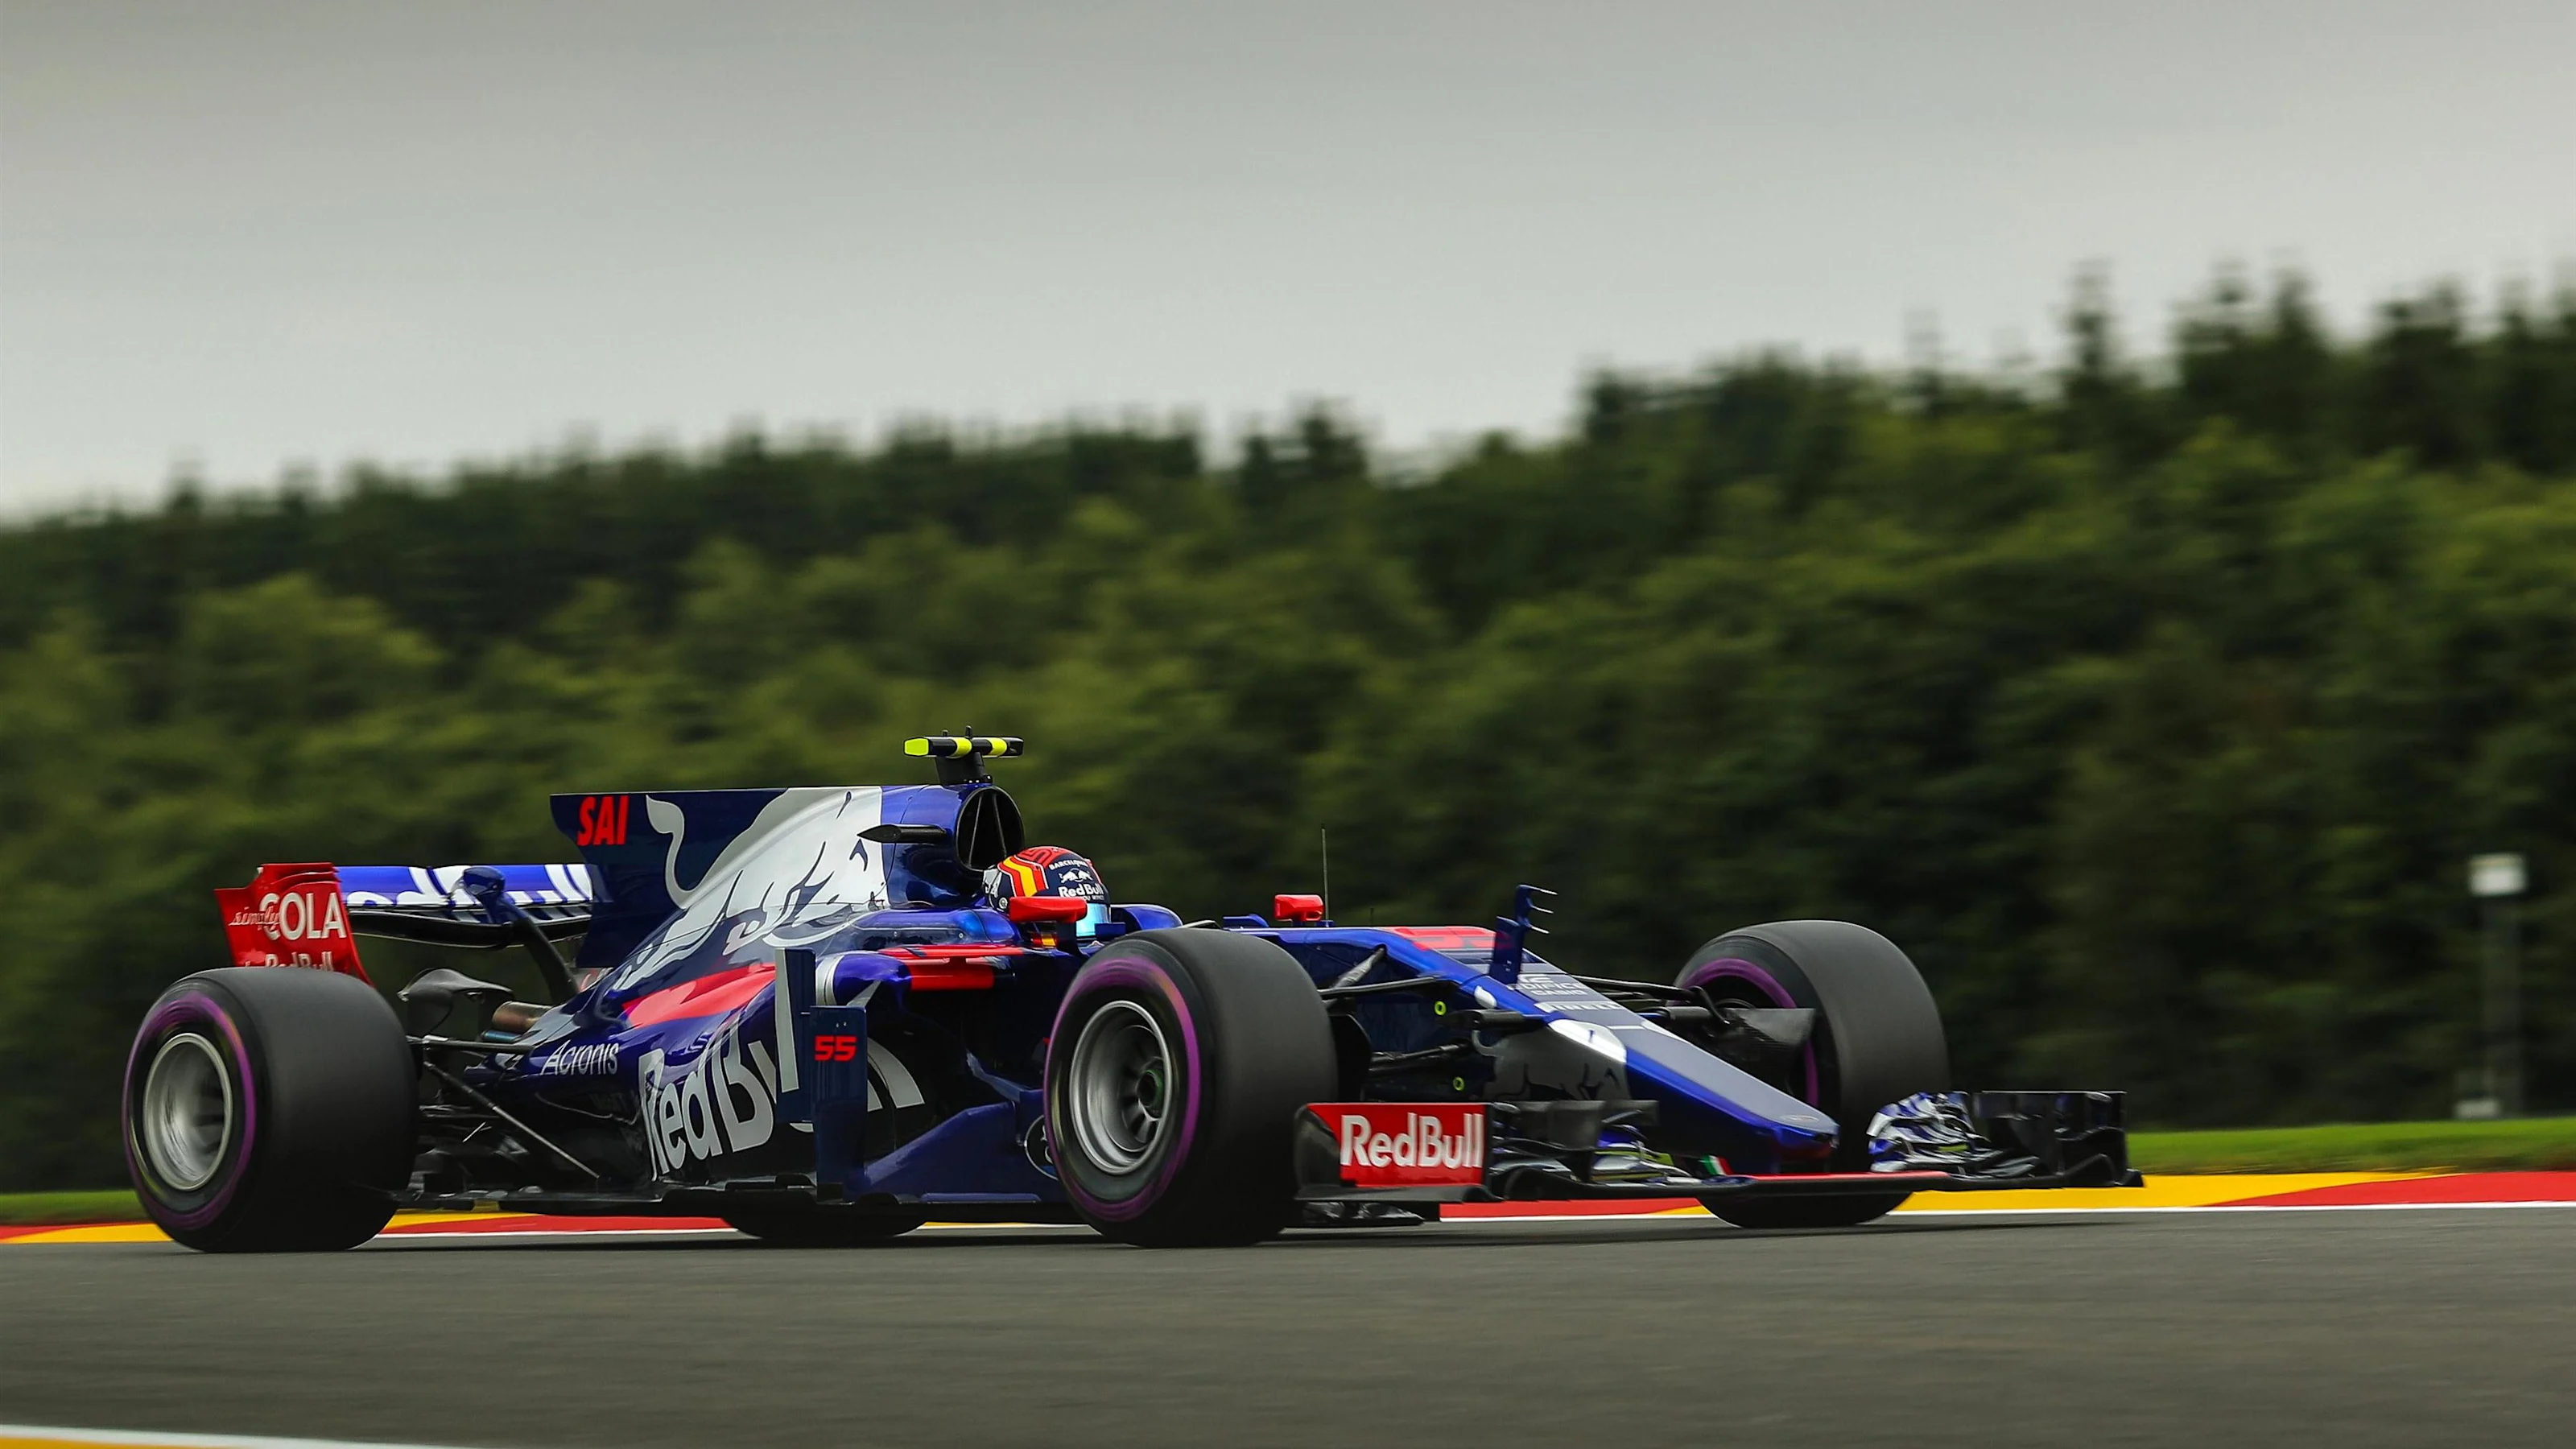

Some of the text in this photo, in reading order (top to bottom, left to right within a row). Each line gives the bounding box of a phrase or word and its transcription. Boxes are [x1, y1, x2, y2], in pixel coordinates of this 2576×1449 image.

[576, 795, 629, 846] SAI
[259, 892, 347, 940] COLA
[539, 1039, 619, 1075] Acronis
[814, 1035, 857, 1062] 55
